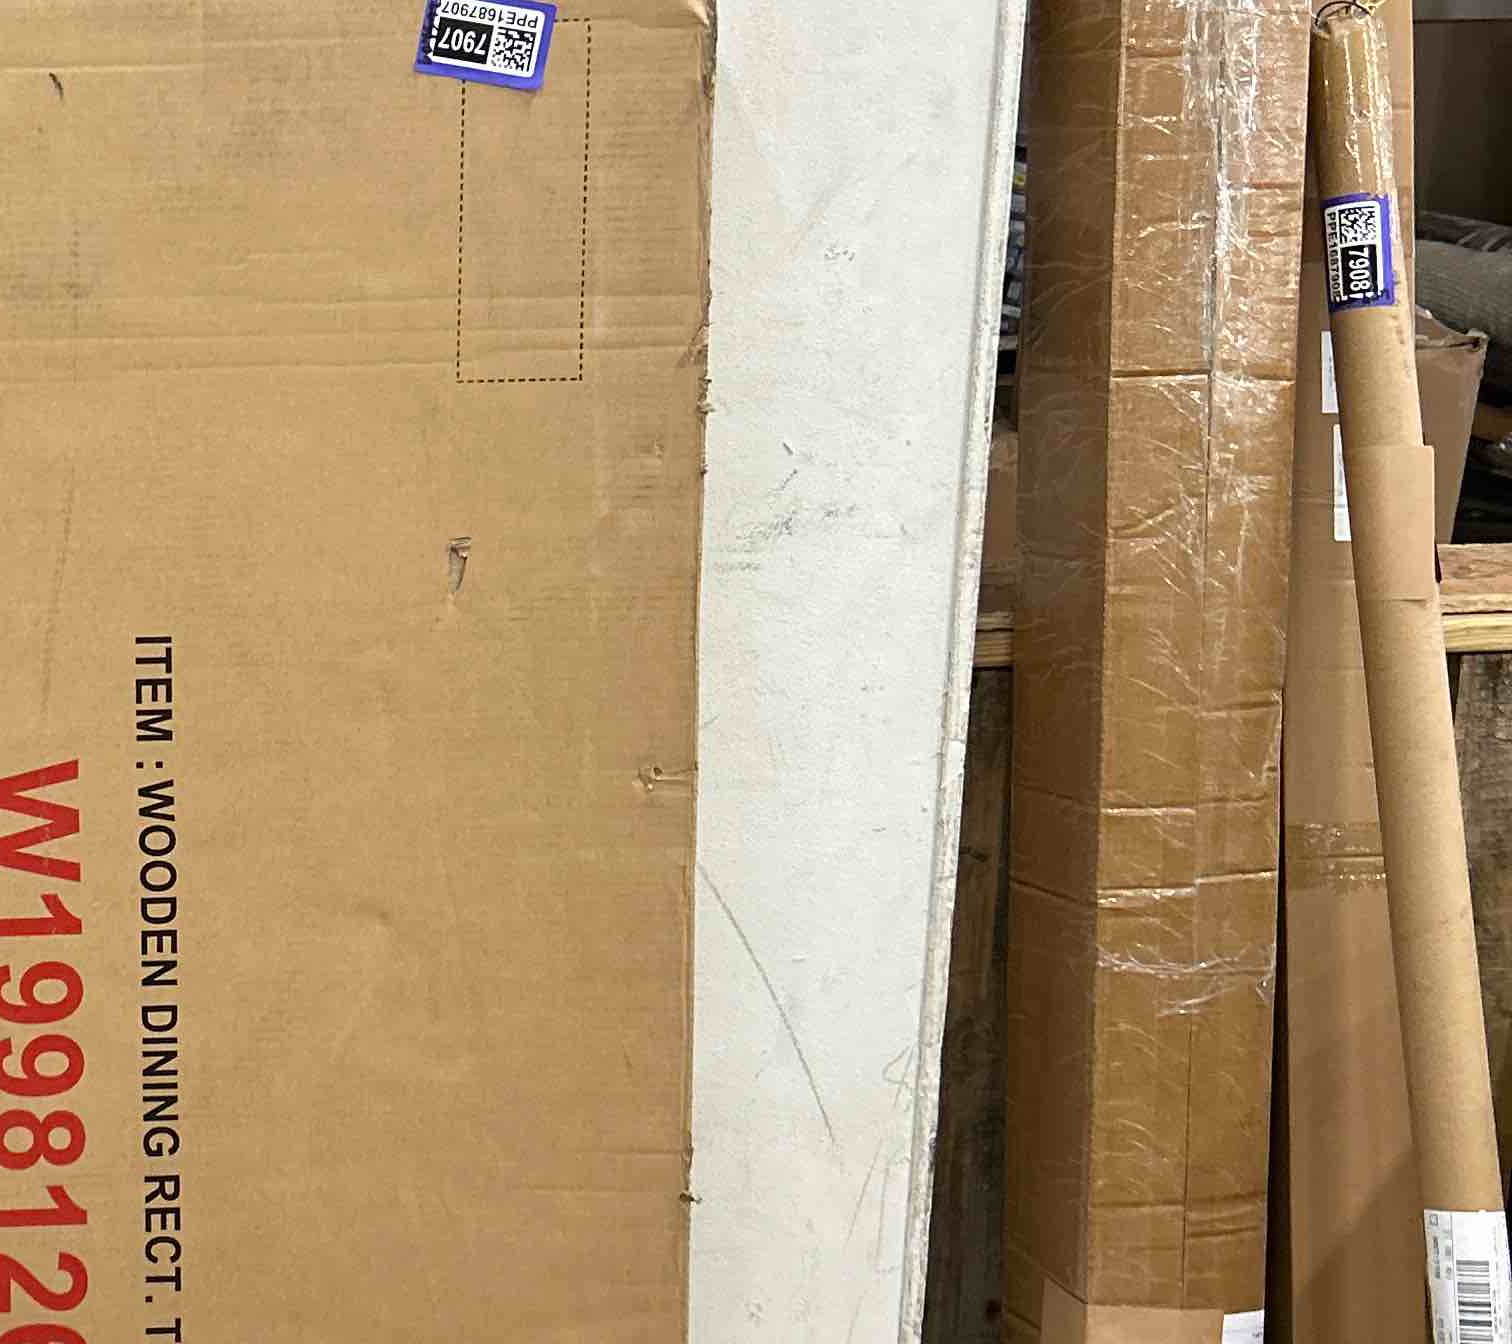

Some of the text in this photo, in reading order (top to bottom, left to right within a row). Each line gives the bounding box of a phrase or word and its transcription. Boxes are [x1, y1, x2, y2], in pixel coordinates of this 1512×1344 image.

[437, 26, 488, 55] 7907
[441, 1, 539, 29] PPE1687907
[1348, 247, 1371, 292] 7908
[137, 778, 178, 987] WOODEN
[141, 1004, 181, 1158] DINING
[143, 1174, 182, 1304] RECT.
